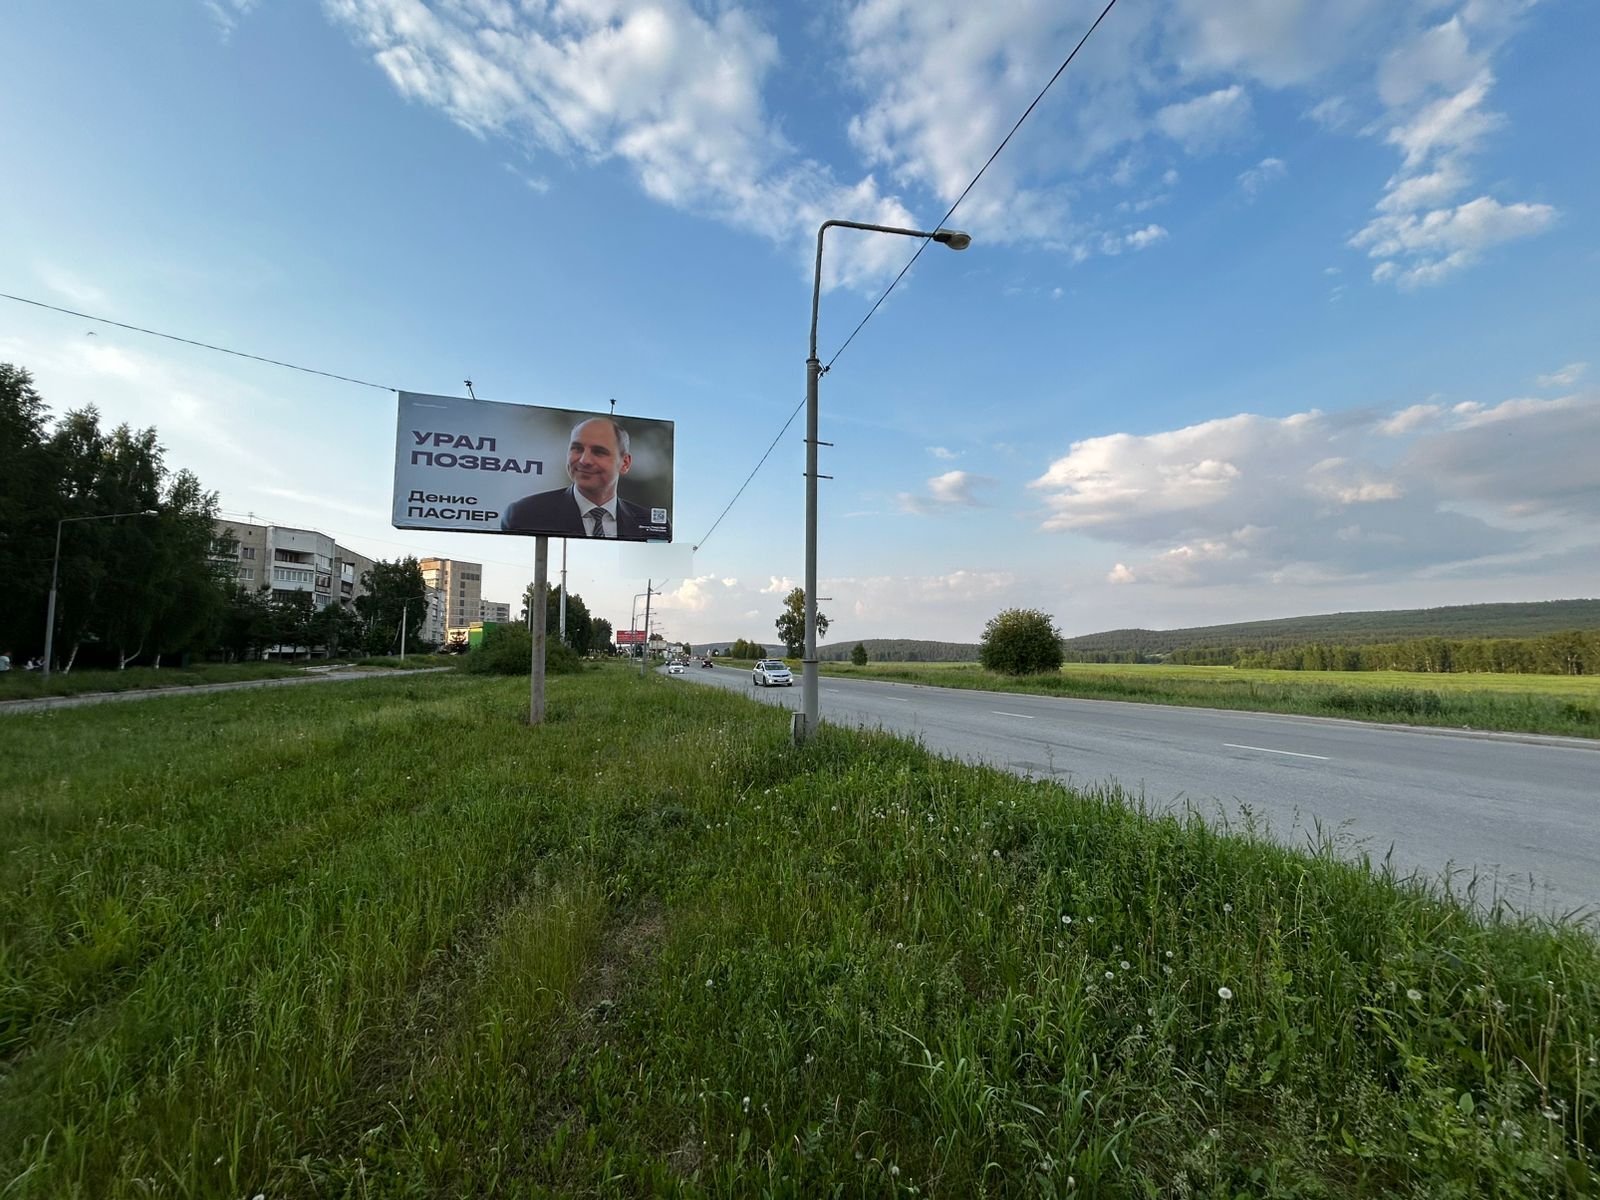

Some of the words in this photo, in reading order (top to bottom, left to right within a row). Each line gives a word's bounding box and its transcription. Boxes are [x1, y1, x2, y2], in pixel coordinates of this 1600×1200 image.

[411, 430, 496, 452] УРАЛ
[411, 450, 543, 475] ПОЗВАЛ
[407, 490, 478, 505] Денис
[407, 506, 499, 522] ПАСЛЕР
